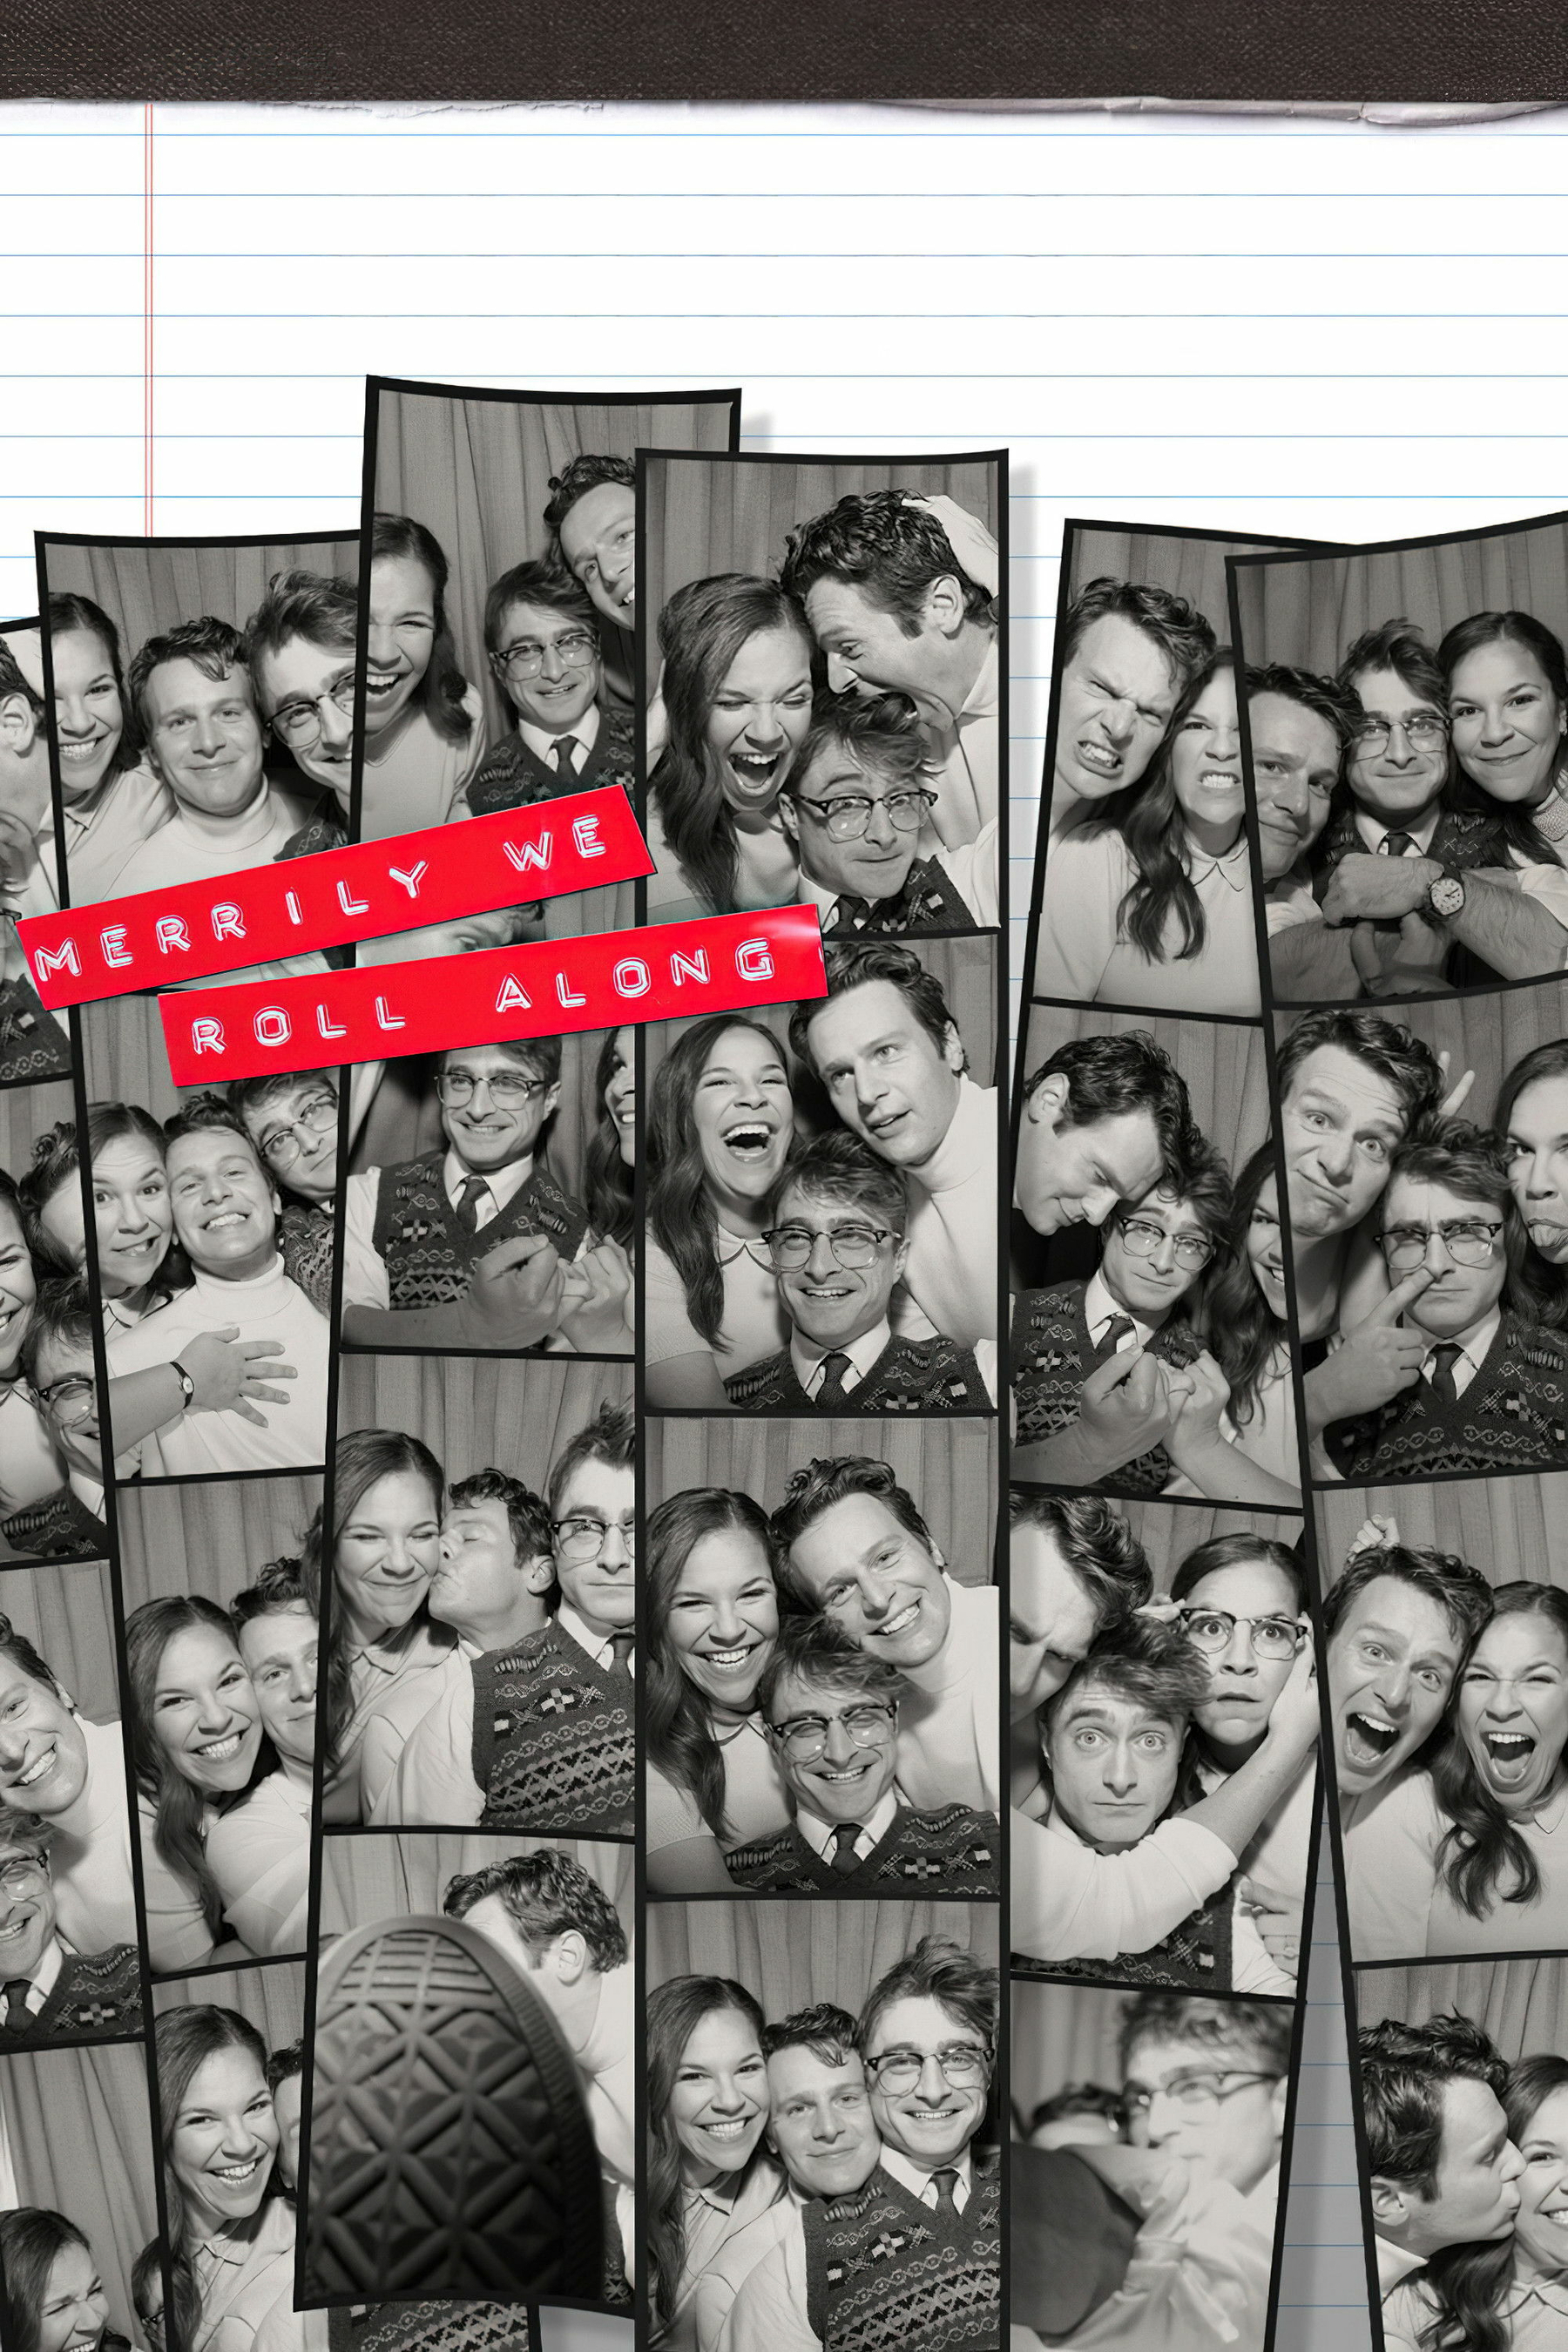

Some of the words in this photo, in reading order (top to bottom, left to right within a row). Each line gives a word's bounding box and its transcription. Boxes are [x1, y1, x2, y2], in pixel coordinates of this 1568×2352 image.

[34, 860, 429, 982] MERRILY
[503, 814, 605, 871] WE
[191, 996, 407, 1055] ROLL
[495, 936, 775, 1013] ALONG
